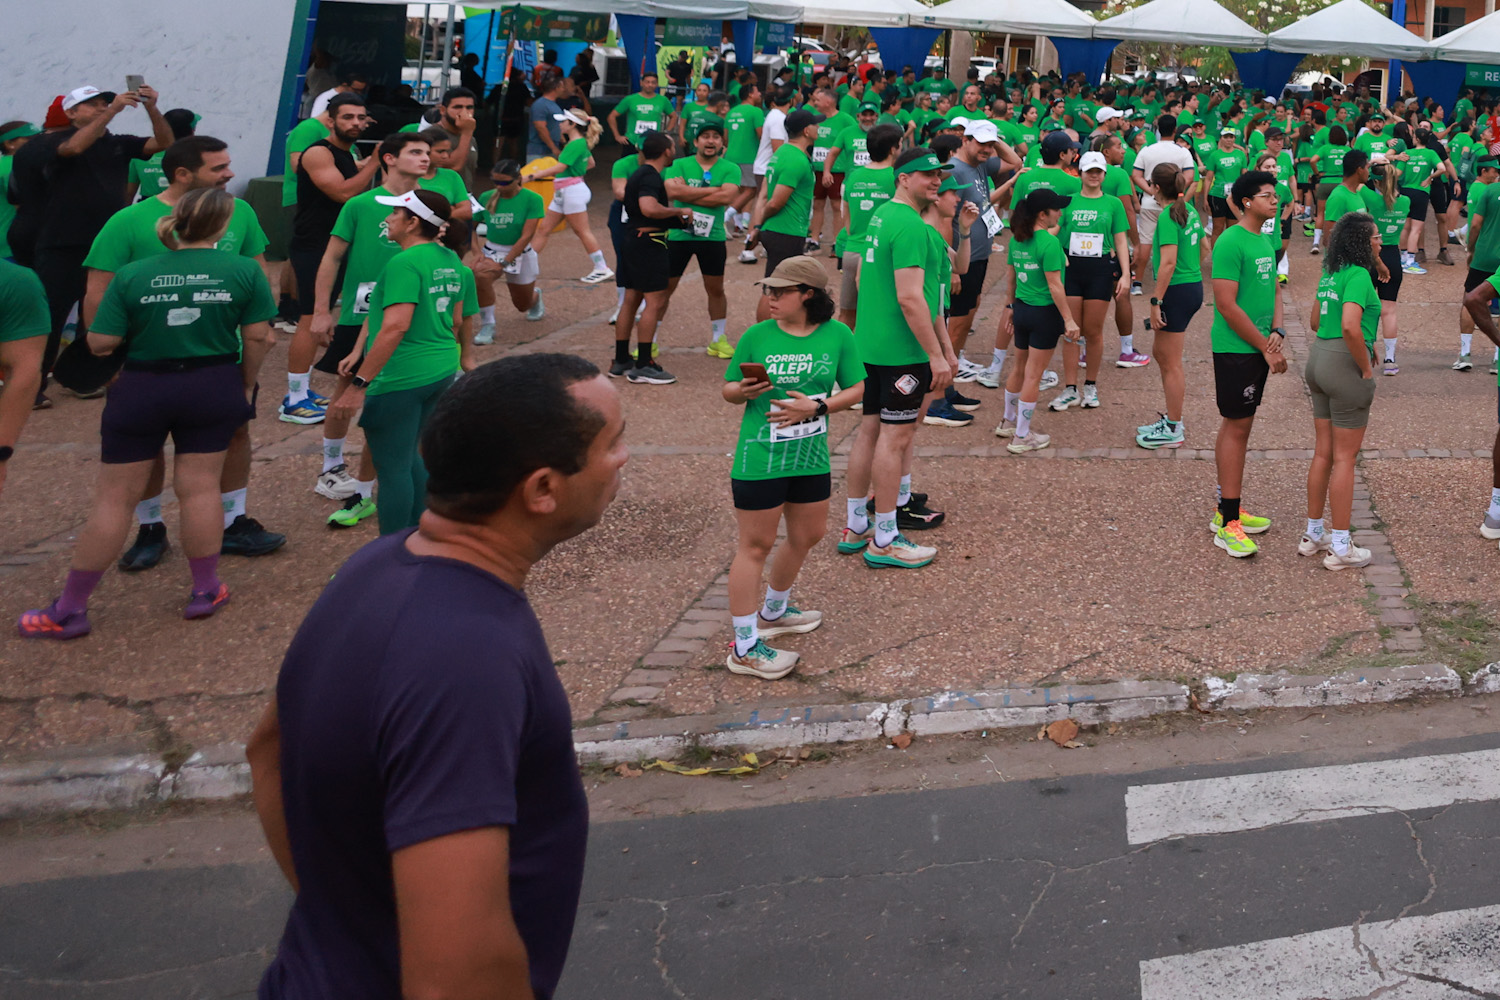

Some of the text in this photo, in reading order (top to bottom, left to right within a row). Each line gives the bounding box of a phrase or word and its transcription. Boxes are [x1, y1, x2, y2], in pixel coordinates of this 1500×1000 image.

[490, 217, 514, 225] ALEPI
[1072, 213, 1098, 221] ALEPI
[1081, 241, 1093, 250] 10
[140, 292, 233, 304] CAIXA BRASIL
[765, 353, 812, 363] CORRIDA
[766, 362, 812, 375] ALEPI
[776, 376, 800, 384] 2026
